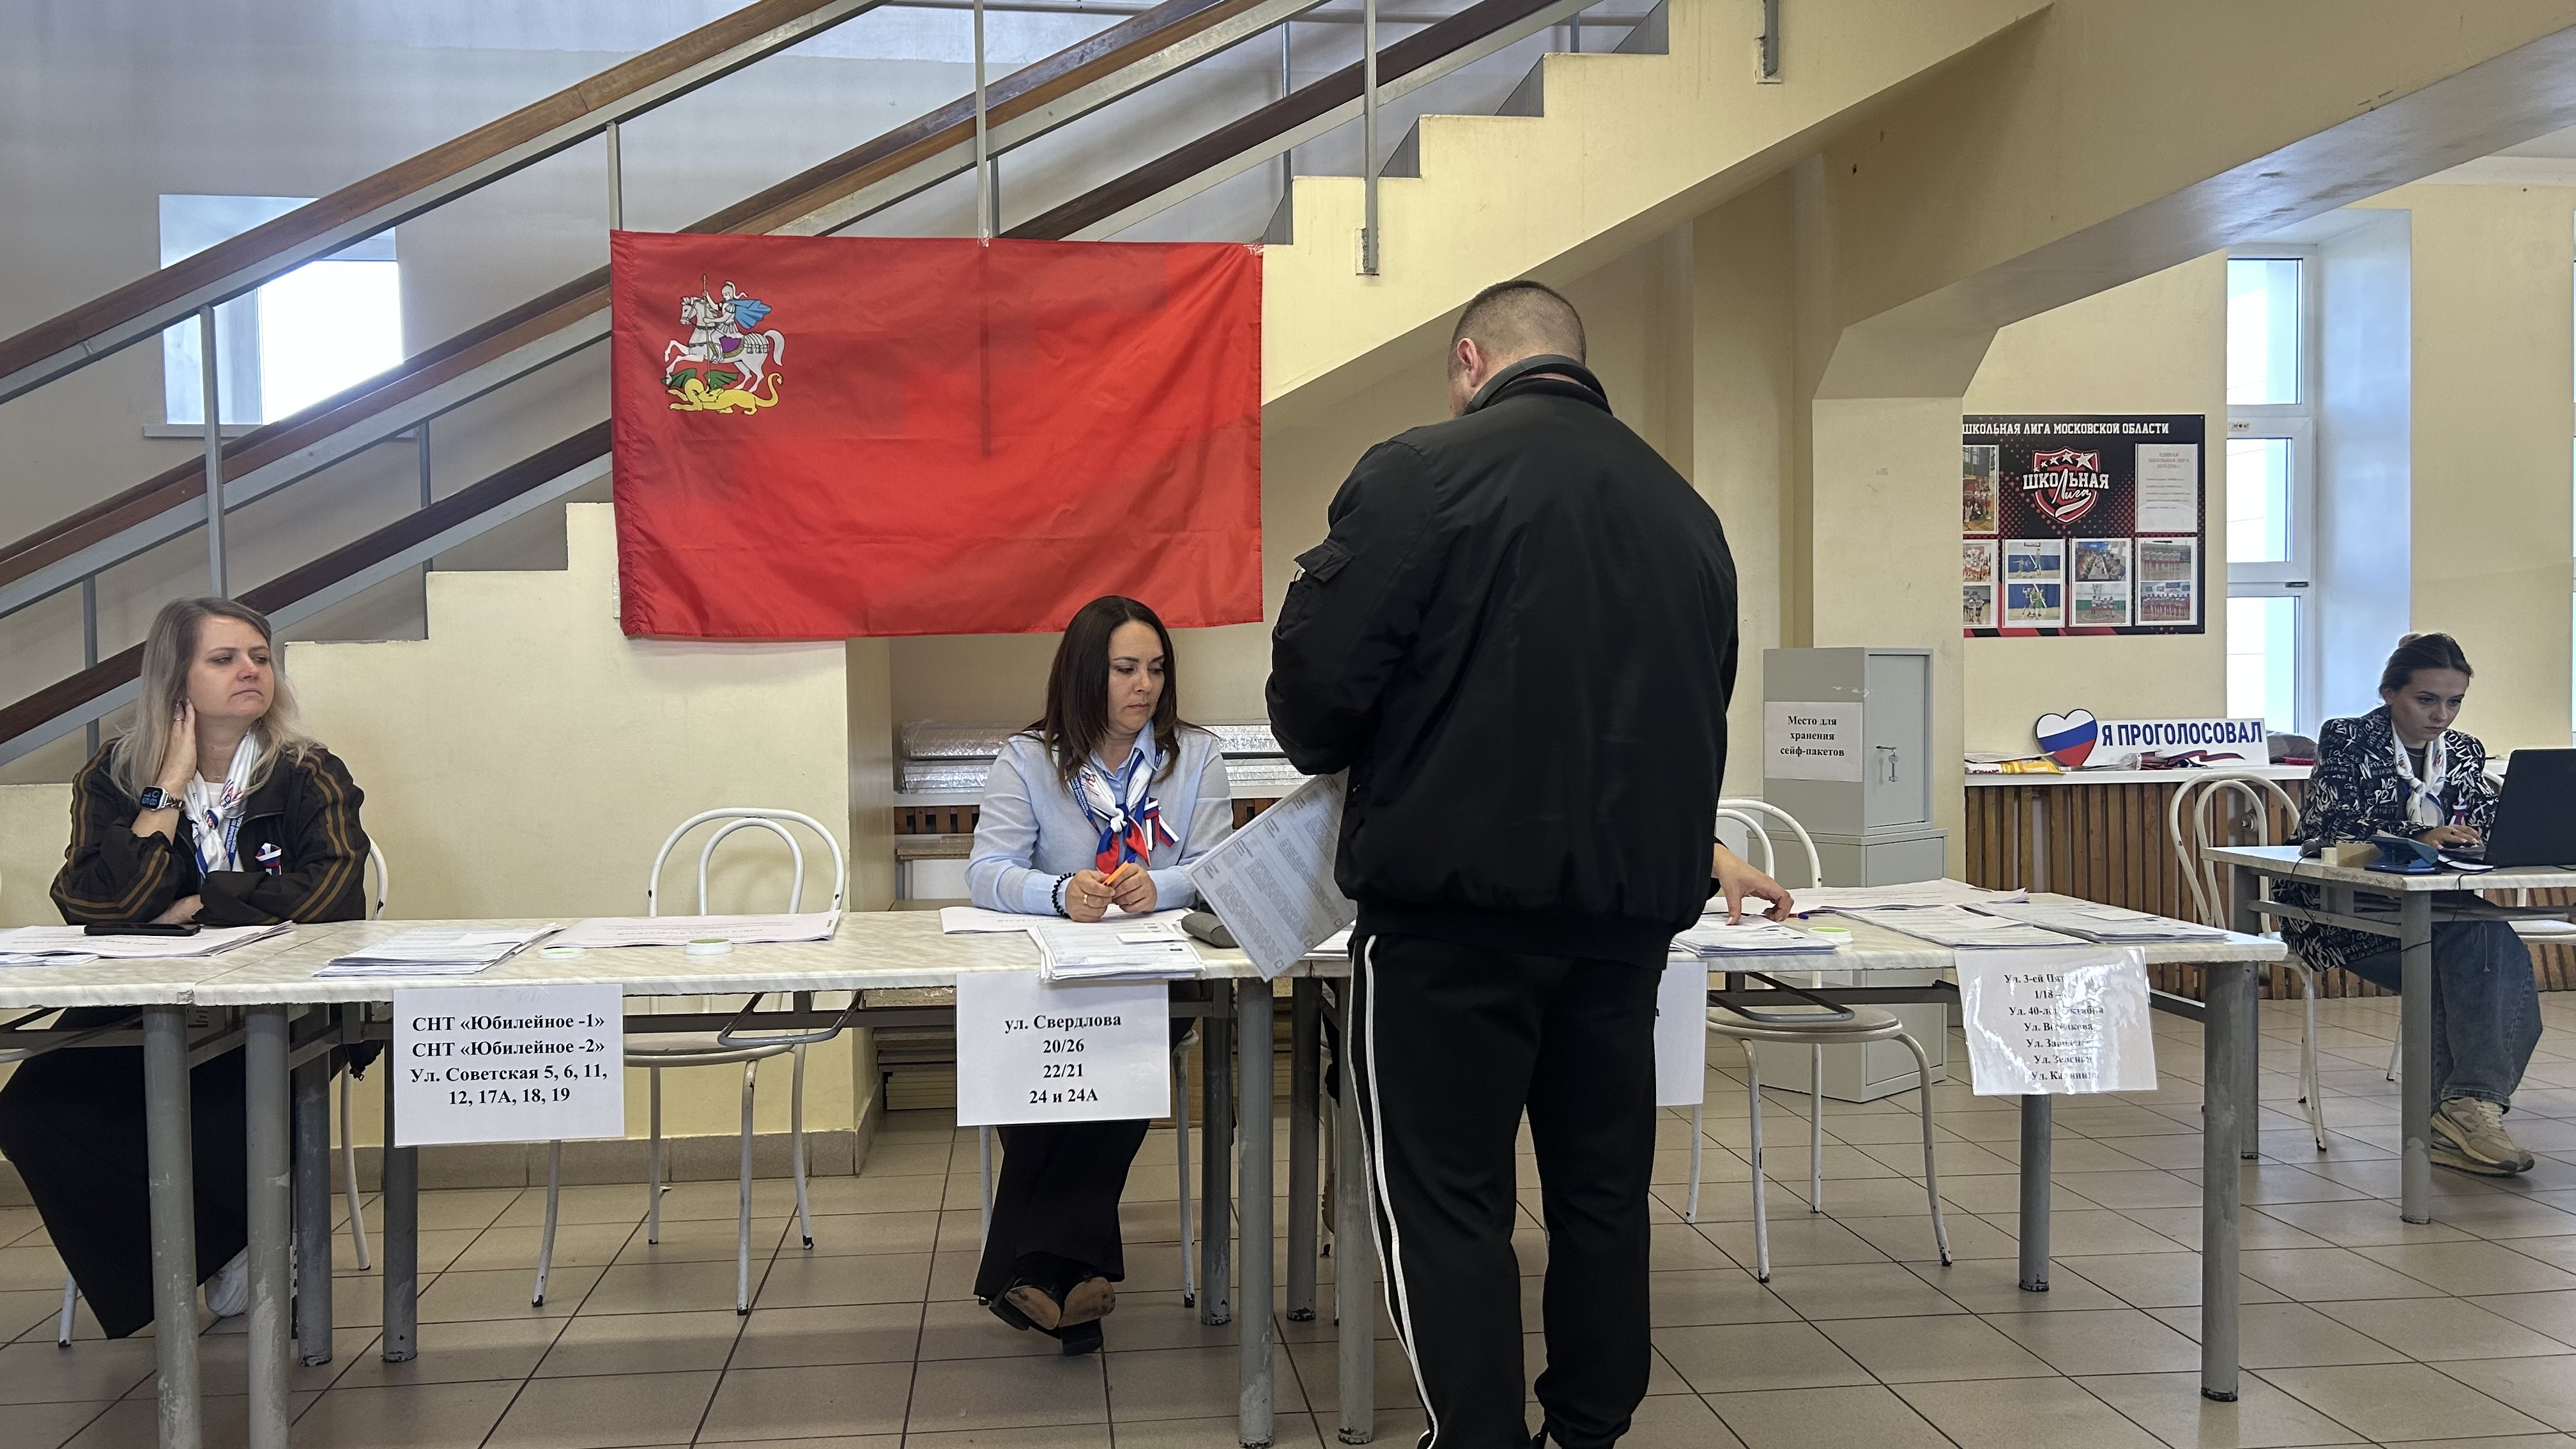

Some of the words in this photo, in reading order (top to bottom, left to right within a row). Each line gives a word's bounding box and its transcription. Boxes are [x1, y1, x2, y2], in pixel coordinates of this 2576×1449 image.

[1963, 423, 2021, 435] ШКОЛЬНАЯ
[2023, 423, 2051, 434] ЛИГА
[2053, 422, 2120, 434] МОСКОВСКОЙ
[2122, 423, 2169, 434] ОБЛАСТИ
[2023, 469, 2110, 493] ШКОЛЬНАЯ
[1787, 716, 1818, 726] Место
[1790, 732, 1835, 742] хранения
[2102, 724, 2113, 746] Я
[2117, 721, 2262, 746] ПРОГОЛОСОВАЛ
[1780, 746, 1844, 758] сейф-пакетов
[2004, 974, 2021, 983] Ул.
[2023, 974, 2044, 983] 3-ей
[2035, 990, 2053, 999] 1/18
[2009, 1007, 2026, 1016] Ул.
[412, 1016, 456, 1031] СНТ
[460, 1015, 574, 1029] «Юбилейное
[579, 1013, 604, 1027] -1»
[1005, 1020, 1028, 1034] ул.
[1034, 1015, 1121, 1031] Свердлова
[2023, 1022, 2041, 1031] Ул.
[412, 1042, 456, 1057] СНТ
[460, 1040, 574, 1055] «Юбилейное
[579, 1039, 605, 1052] -2»
[1043, 1038, 1084, 1053] 20/26
[2026, 1039, 2043, 1048] Ул.
[2034, 1055, 2051, 1064] Ул.
[410, 1069, 440, 1082] Ул.
[445, 1067, 539, 1082] Советская
[544, 1065, 559, 1081] 5,
[564, 1064, 578, 1080] 6,
[584, 1064, 608, 1080] 11,
[1043, 1064, 1082, 1078] 22/21
[2032, 1071, 2047, 1080] Ул.
[449, 1091, 473, 1107] 12,
[479, 1090, 517, 1105] 17А,
[523, 1089, 546, 1105] 18,
[552, 1088, 570, 1101] 19
[1029, 1090, 1047, 1104] 24
[1052, 1093, 1062, 1103] и
[1068, 1088, 1098, 1102] 24А
